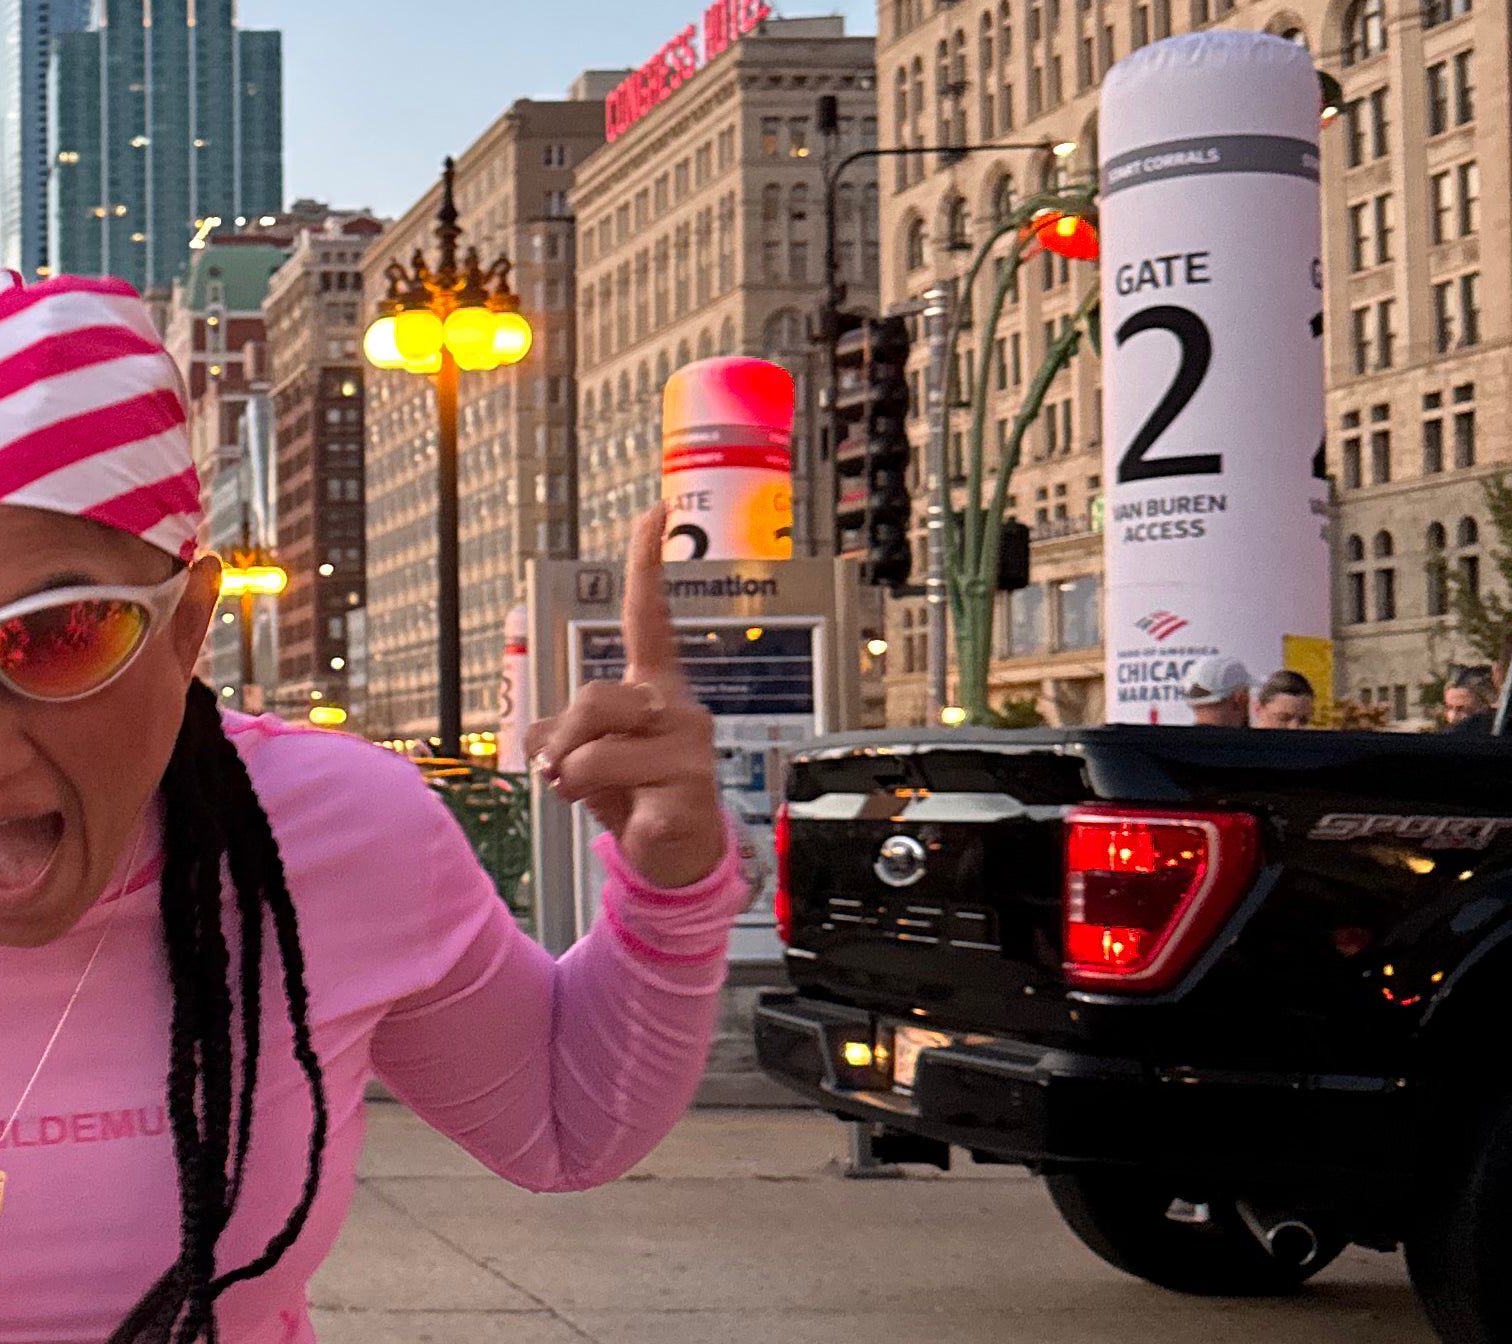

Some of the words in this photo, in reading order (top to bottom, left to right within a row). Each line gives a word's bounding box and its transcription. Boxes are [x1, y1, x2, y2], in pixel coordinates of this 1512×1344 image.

[1143, 147, 1221, 173] CORRALS
[1115, 251, 1212, 296] GATE
[1115, 304, 1223, 485] 2
[666, 490, 713, 513] ATE
[1146, 494, 1227, 518] BUREN
[1124, 518, 1206, 543] ACCESS
[1117, 659, 1196, 684] CHICA
[1117, 684, 1189, 703] MARATH
